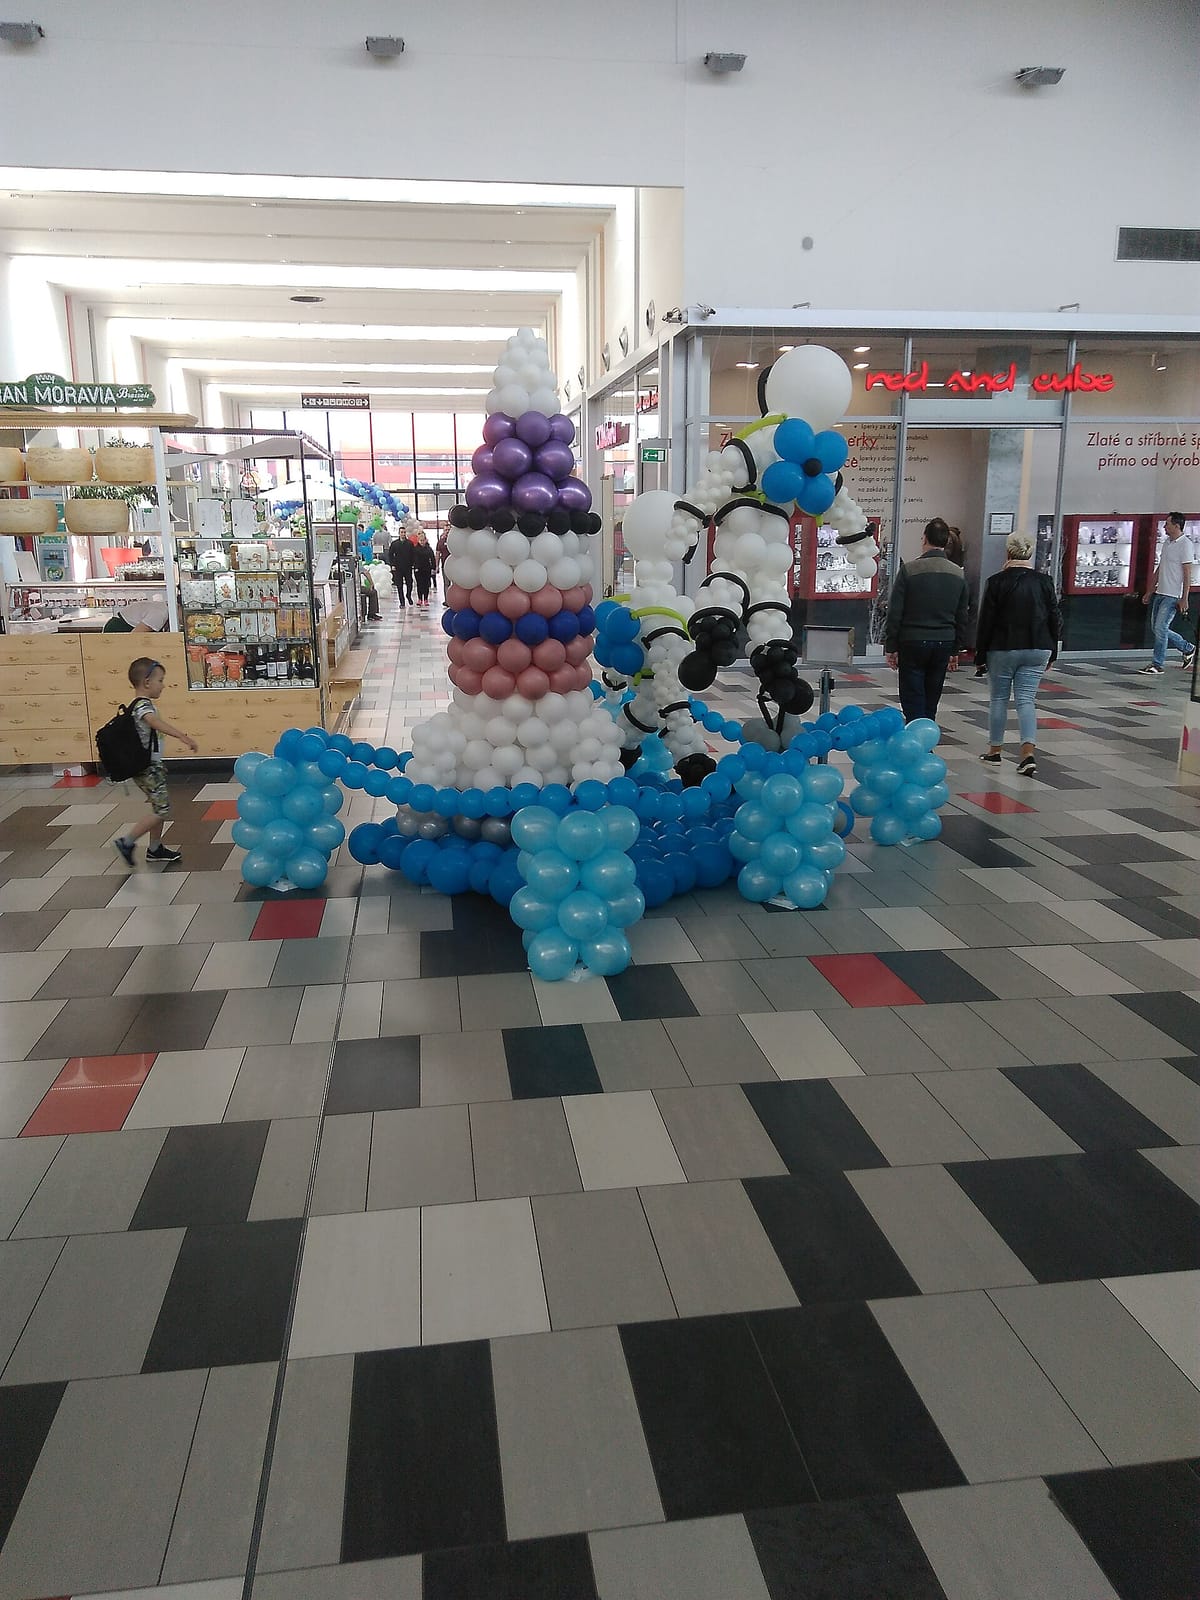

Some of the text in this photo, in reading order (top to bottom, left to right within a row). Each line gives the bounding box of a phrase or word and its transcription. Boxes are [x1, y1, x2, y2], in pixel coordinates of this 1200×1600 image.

[865, 360, 929, 392] red
[1032, 361, 1115, 392] cube
[0, 385, 117, 404] AN MORAVIA
[847, 432, 878, 449] erky
[1087, 432, 1121, 446] Zlaté
[1125, 437, 1133, 446] a
[1138, 432, 1187, 447] stříbrné
[1098, 453, 1137, 471] přímo
[1141, 452, 1159, 467] od
